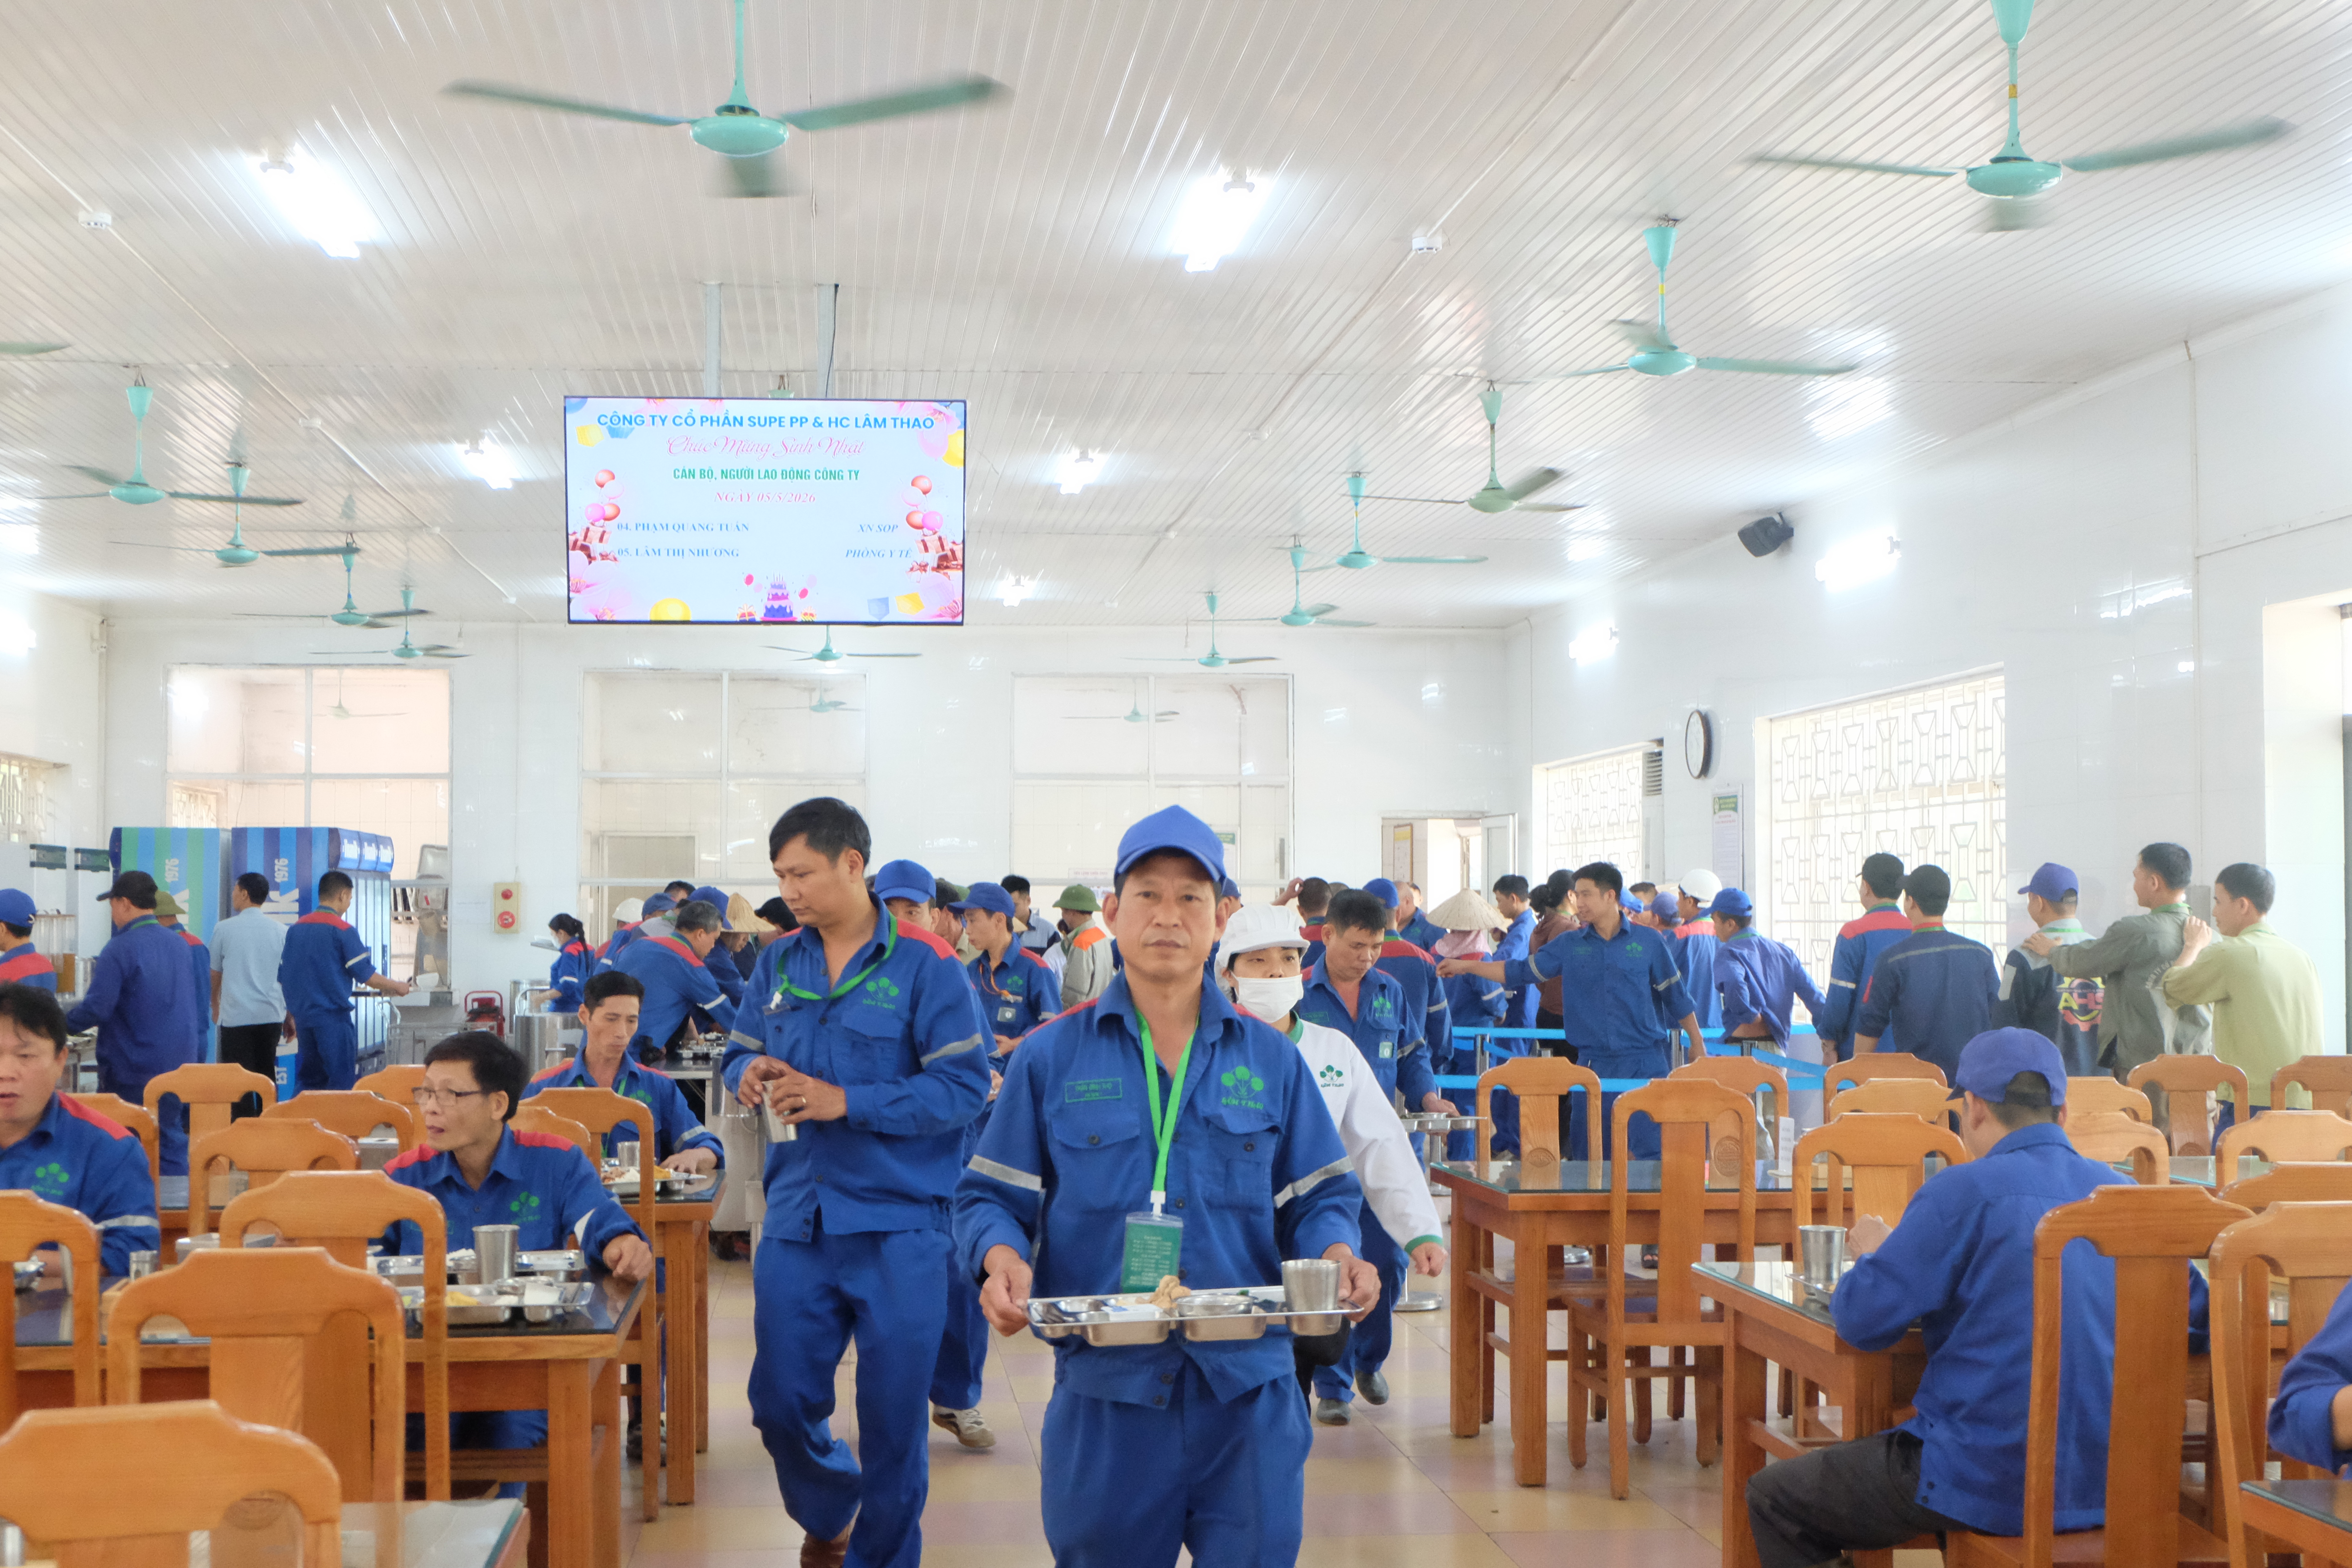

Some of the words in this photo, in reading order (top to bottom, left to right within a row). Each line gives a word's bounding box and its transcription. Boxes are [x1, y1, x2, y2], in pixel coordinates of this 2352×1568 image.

[598, 411, 645, 426] CÔNG
[649, 415, 668, 427] TY
[673, 409, 696, 427] CỔ
[700, 409, 744, 427] PHẦN
[748, 416, 785, 428] SUPE
[790, 416, 808, 428] PP
[812, 416, 823, 428] &
[828, 417, 850, 428] HC
[855, 414, 887, 429] LÂM
[891, 417, 934, 429] THAO
[668, 435, 712, 455] Chúc
[772, 436, 814, 457] Sinh
[674, 466, 696, 480] CÁN
[699, 466, 717, 482] BỘ,
[721, 466, 754, 480] NGƯỜI
[758, 469, 777, 480] LAO
[781, 467, 810, 483] ĐỘNG
[815, 467, 844, 481] CÔNG
[848, 469, 860, 481] TY
[714, 490, 753, 502] NGÀY
[757, 492, 816, 503] 05/5/2026
[617, 523, 631, 531] 04.
[635, 523, 669, 534] PHẠM
[672, 523, 713, 533] QUANG
[858, 524, 874, 533] XN
[876, 524, 898, 533] SOP
[618, 548, 632, 557] 05.
[636, 546, 661, 557] LÂM
[664, 548, 685, 559] THỊ
[845, 547, 885, 558] PHÒNG
[889, 549, 895, 558] Y
[165, 858, 179, 882] 1976
[274, 858, 288, 882] 1976
[274, 1066, 287, 1085] EST
